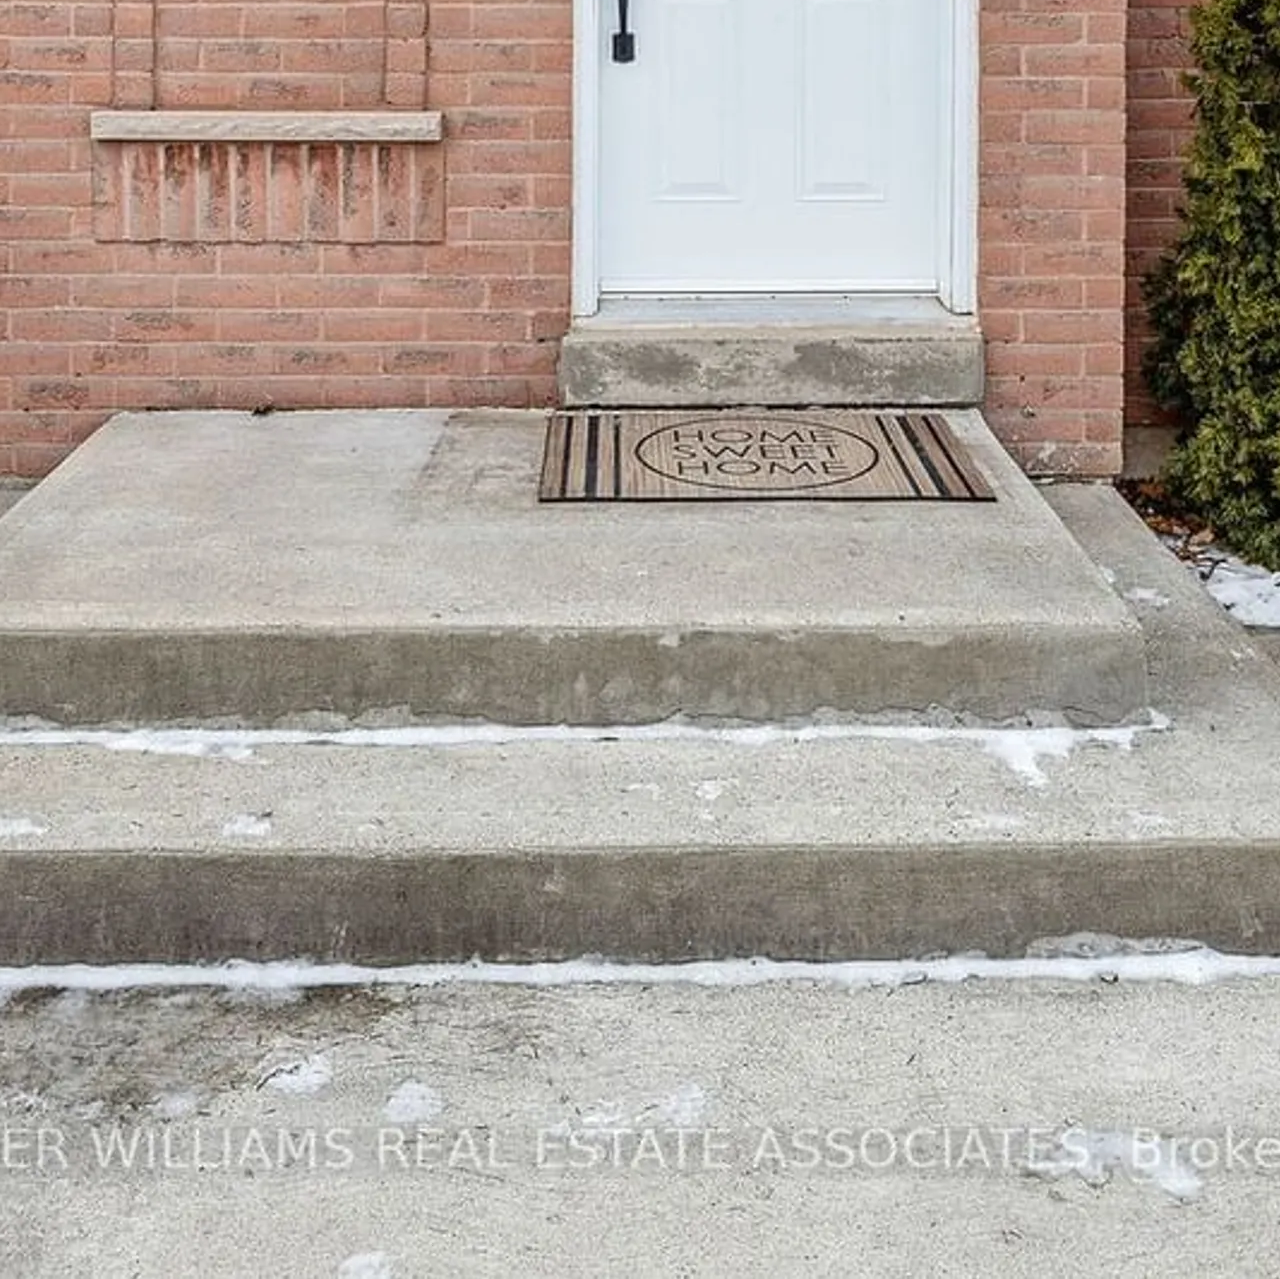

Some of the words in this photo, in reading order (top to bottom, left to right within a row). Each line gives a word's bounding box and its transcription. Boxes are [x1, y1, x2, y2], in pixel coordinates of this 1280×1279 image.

[673, 429, 834, 443] HOME
[672, 444, 839, 459] SWEET
[677, 460, 848, 475] HOME
